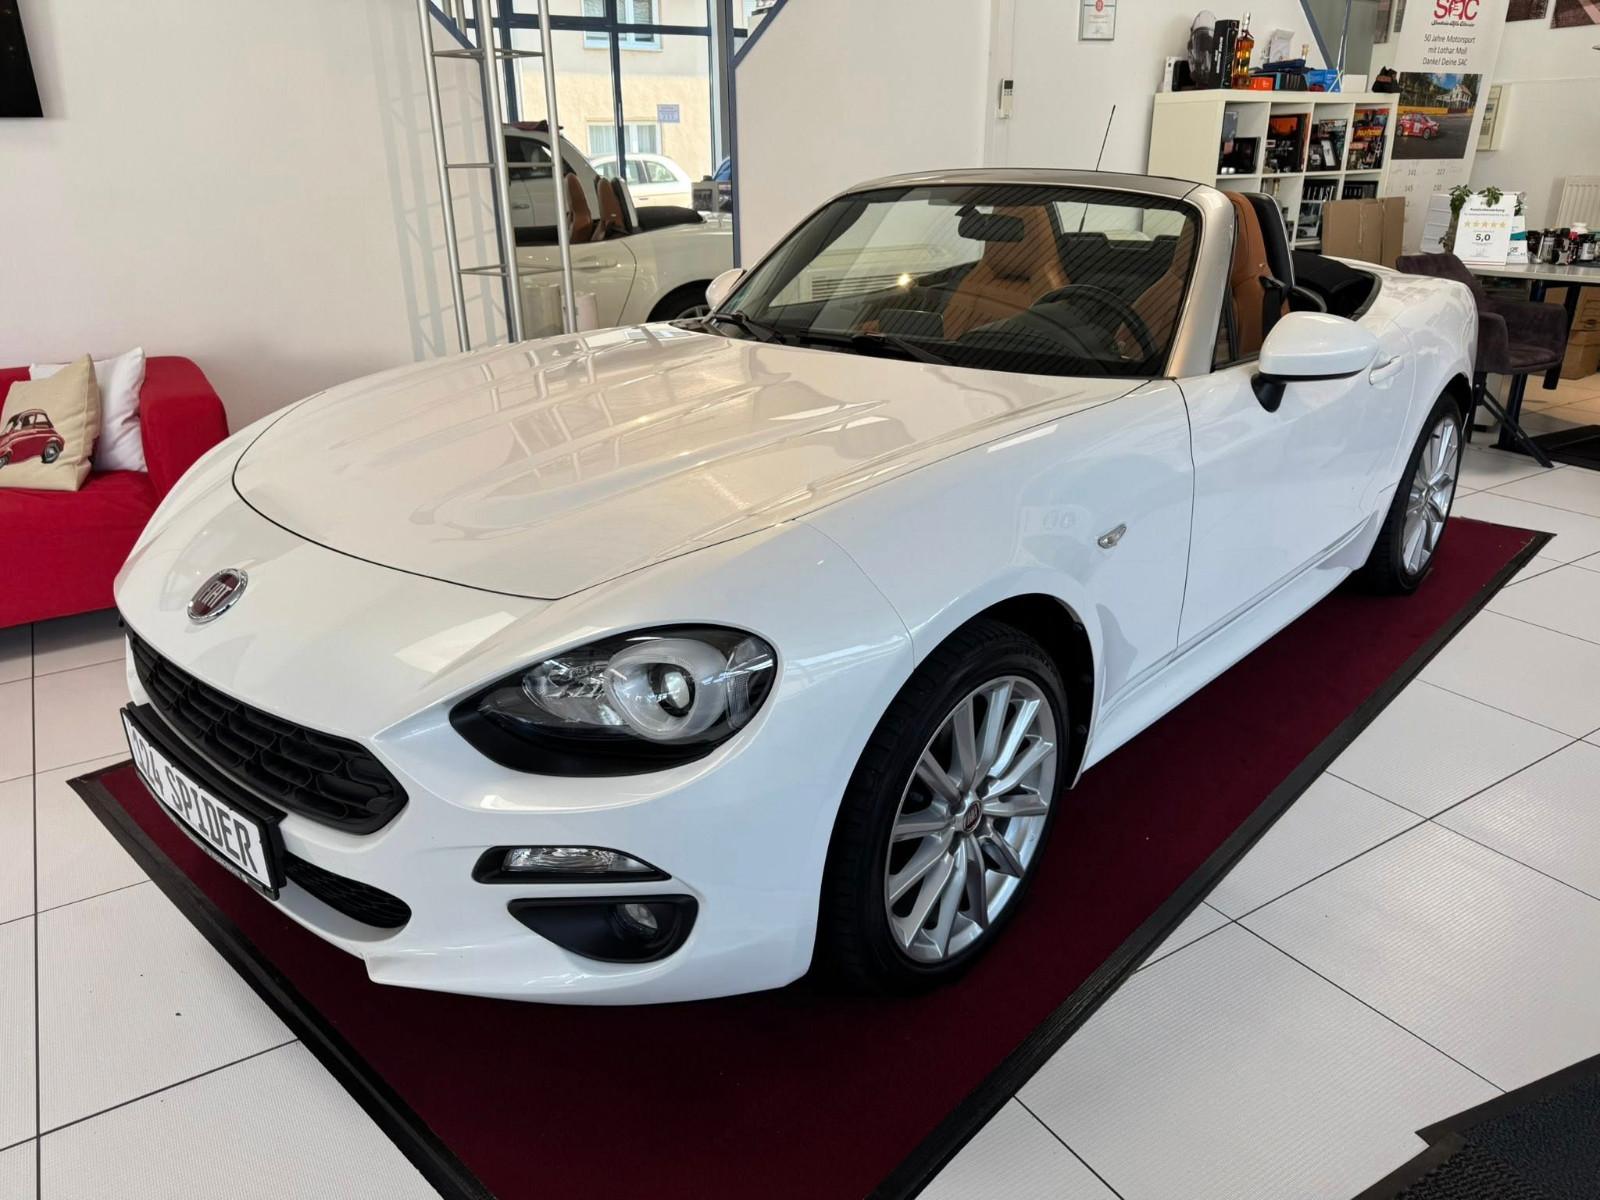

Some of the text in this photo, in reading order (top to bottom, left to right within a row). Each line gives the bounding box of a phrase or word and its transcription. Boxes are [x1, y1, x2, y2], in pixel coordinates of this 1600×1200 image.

[1447, 35, 1476, 44] Motorsport
[1475, 233, 1491, 242] 5,0
[198, 580, 233, 609] FIAT
[164, 764, 258, 874] SPIDER
